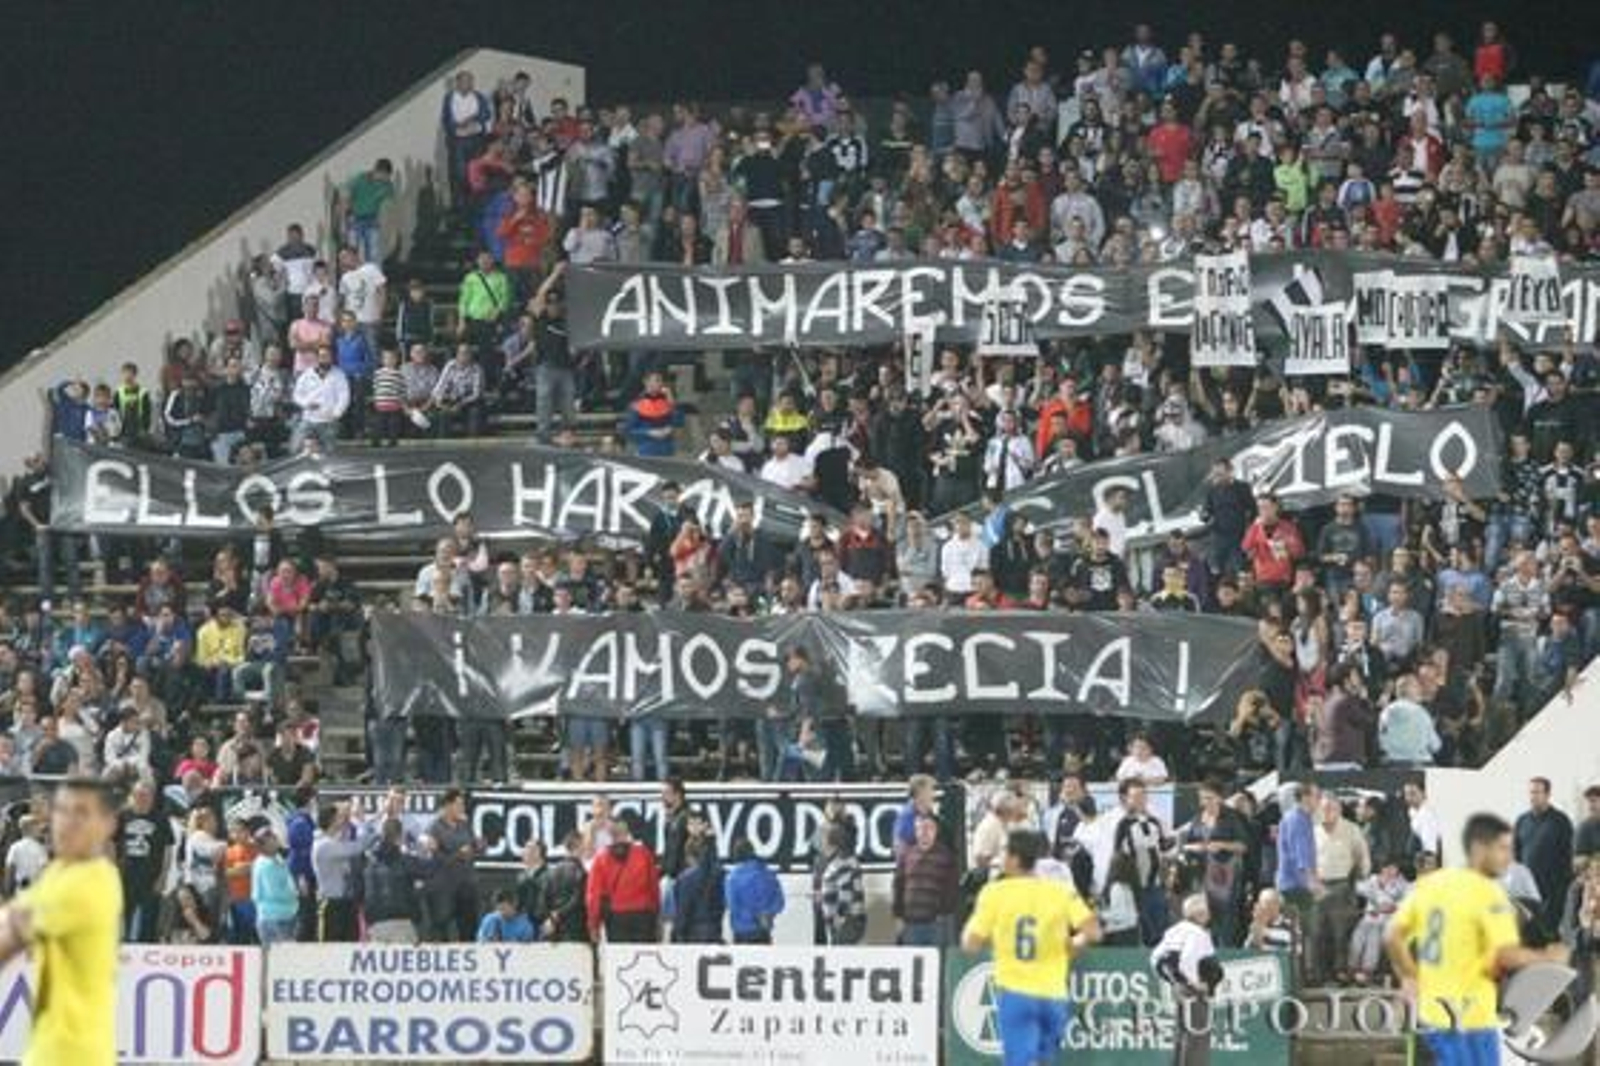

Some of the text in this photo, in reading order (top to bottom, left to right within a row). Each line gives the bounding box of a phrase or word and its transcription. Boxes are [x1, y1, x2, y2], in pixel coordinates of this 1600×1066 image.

[602, 267, 1107, 337] ANIMAREMOS
[84, 459, 335, 528] ELLOS
[374, 462, 473, 524] LO
[350, 949, 513, 973] MUEBLES Y
[1014, 914, 1037, 962] 6
[1420, 908, 1442, 966] 8
[697, 953, 924, 1003] Central
[1069, 970, 1150, 1003] UTOS
[286, 1016, 575, 1055] BARROSO
[1058, 1018, 1176, 1051] GUIRRE
